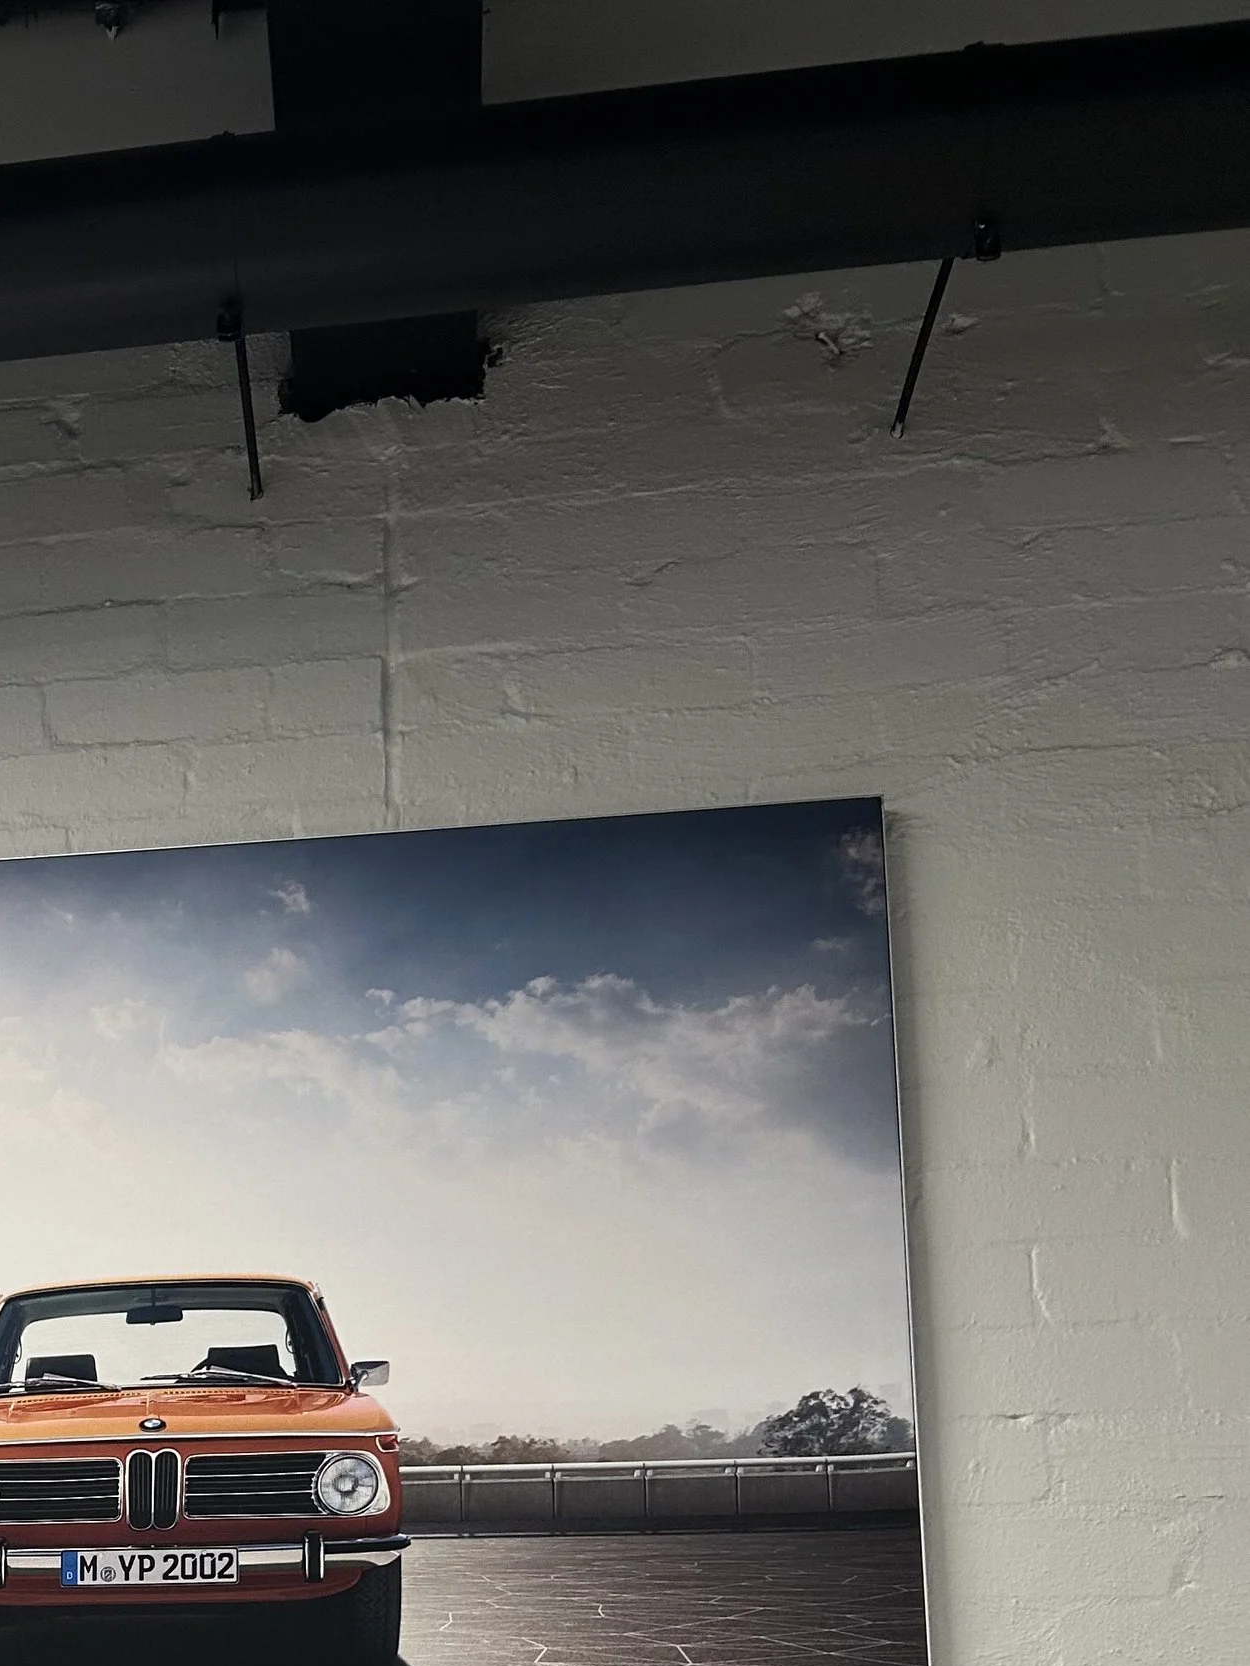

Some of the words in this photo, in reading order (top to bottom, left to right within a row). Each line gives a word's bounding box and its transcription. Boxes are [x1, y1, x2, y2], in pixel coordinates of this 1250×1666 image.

[66, 1571, 73, 1580] D
[79, 1555, 98, 1582] M
[118, 1554, 156, 1582] YP
[162, 1552, 235, 1581] 2002
